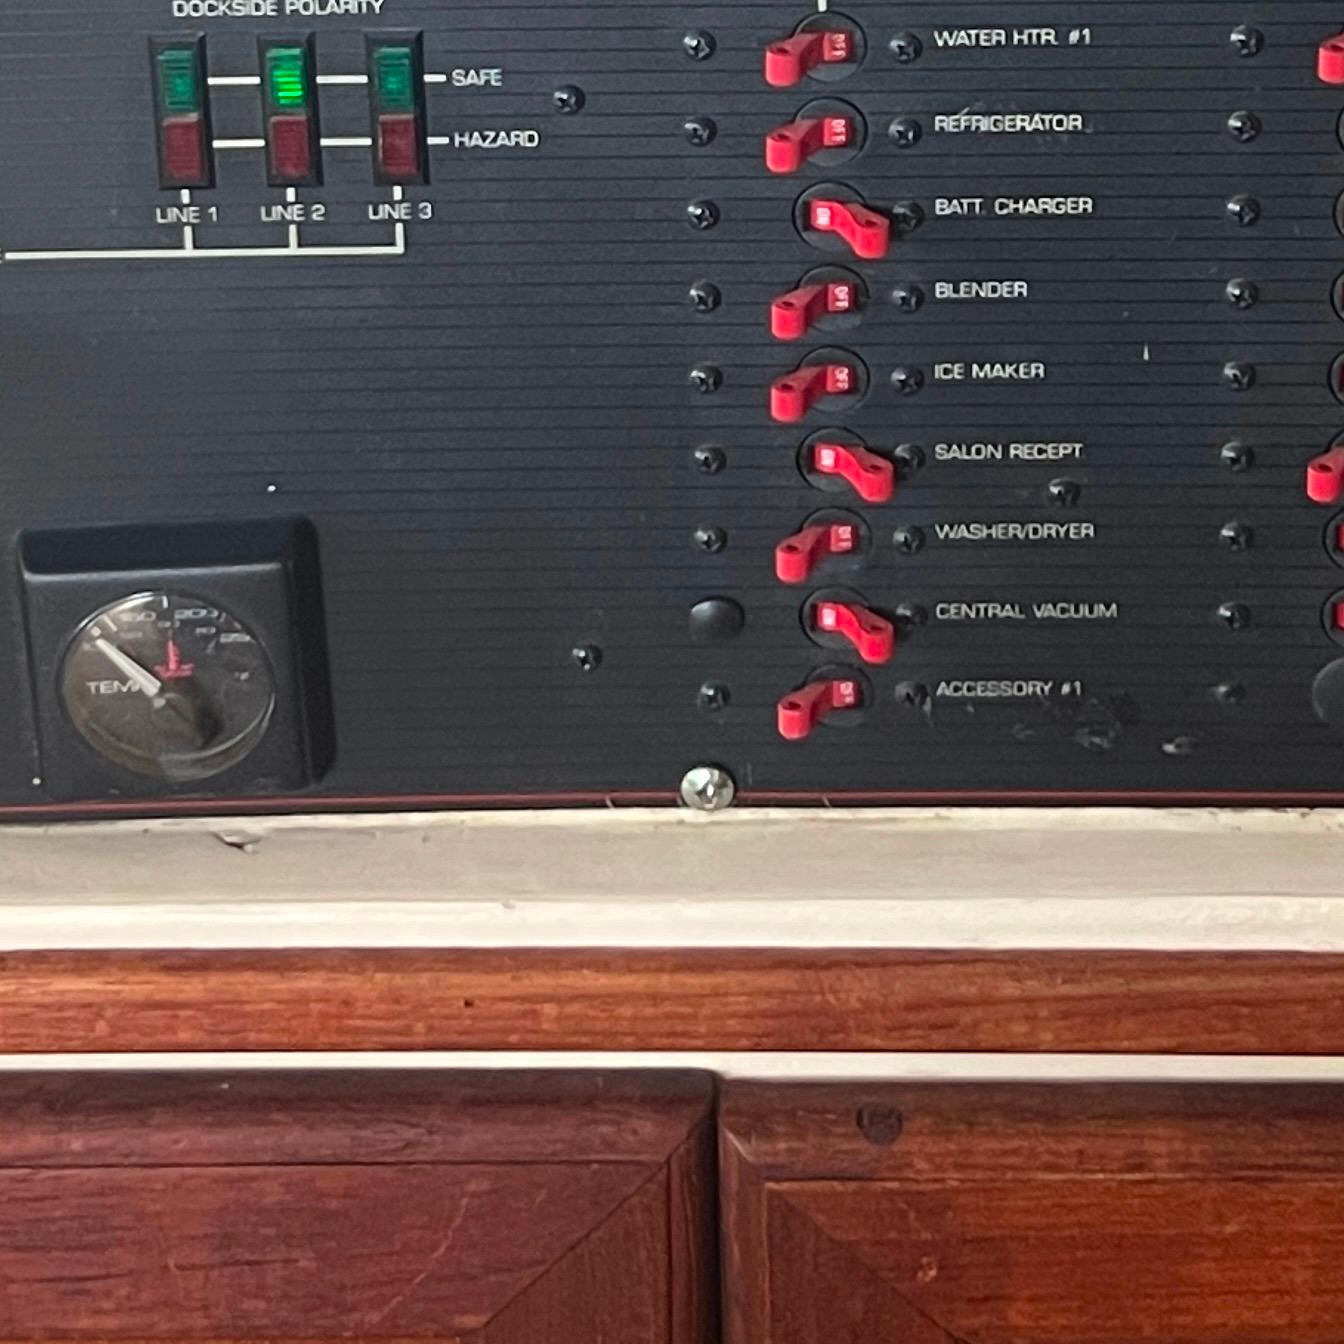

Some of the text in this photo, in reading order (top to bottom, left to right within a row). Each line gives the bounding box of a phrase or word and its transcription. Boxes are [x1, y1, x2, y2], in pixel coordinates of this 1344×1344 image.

[934, 30, 1006, 46] WATER
[1069, 29, 1092, 45] #1
[453, 69, 502, 87] SAFE
[935, 115, 1084, 132] REFRIGERATOR
[454, 130, 538, 149] HAZARD
[156, 206, 218, 223] LINE 1
[261, 204, 326, 221] LINE 2
[368, 202, 432, 219] LINE 3
[994, 198, 1092, 215] CHARGER
[935, 282, 1027, 298] BLENDER
[935, 363, 1045, 379] ICE MAKER
[935, 444, 1002, 460] SALON
[935, 523, 1094, 540] WASHER/DRYER
[936, 603, 1118, 619] CENTRAL VACUUM
[936, 680, 1082, 697] ACCESSORY #1
